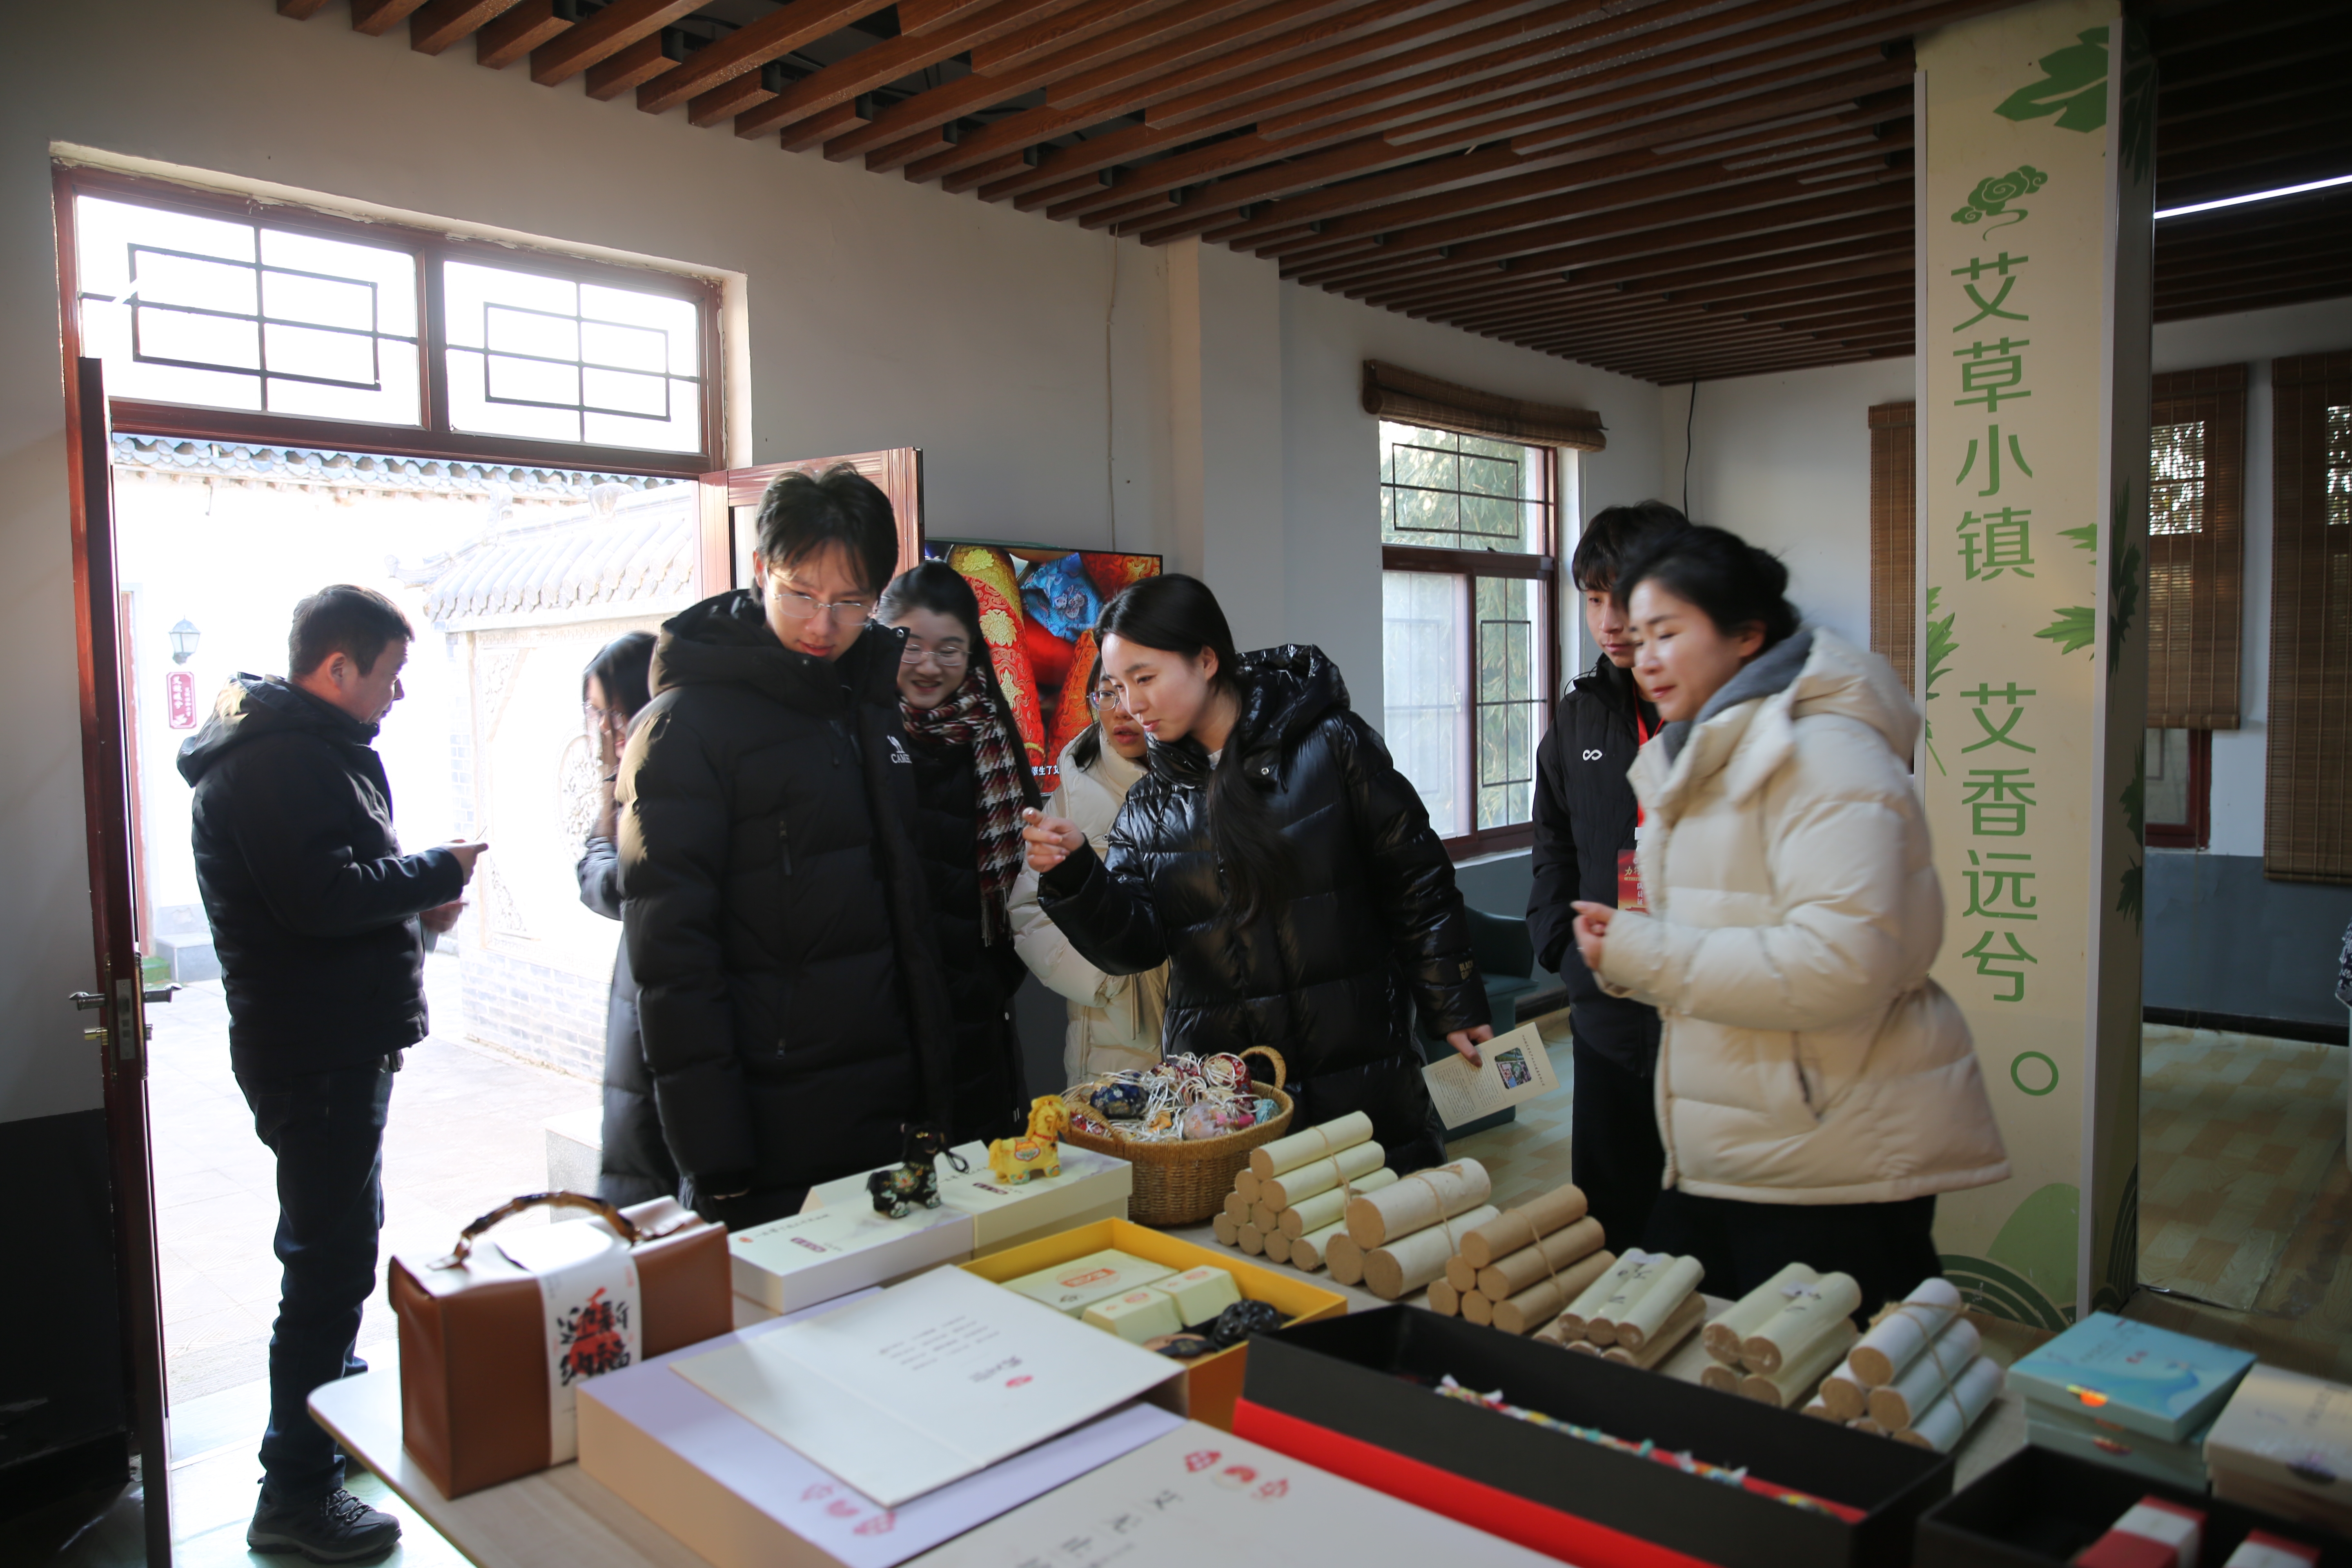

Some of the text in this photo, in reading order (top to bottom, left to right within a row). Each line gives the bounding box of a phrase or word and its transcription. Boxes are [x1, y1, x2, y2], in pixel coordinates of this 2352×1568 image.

[891, 753, 912, 764] CAME
[1951, 252, 2038, 1002] 艾草小镇 艾香远兮
